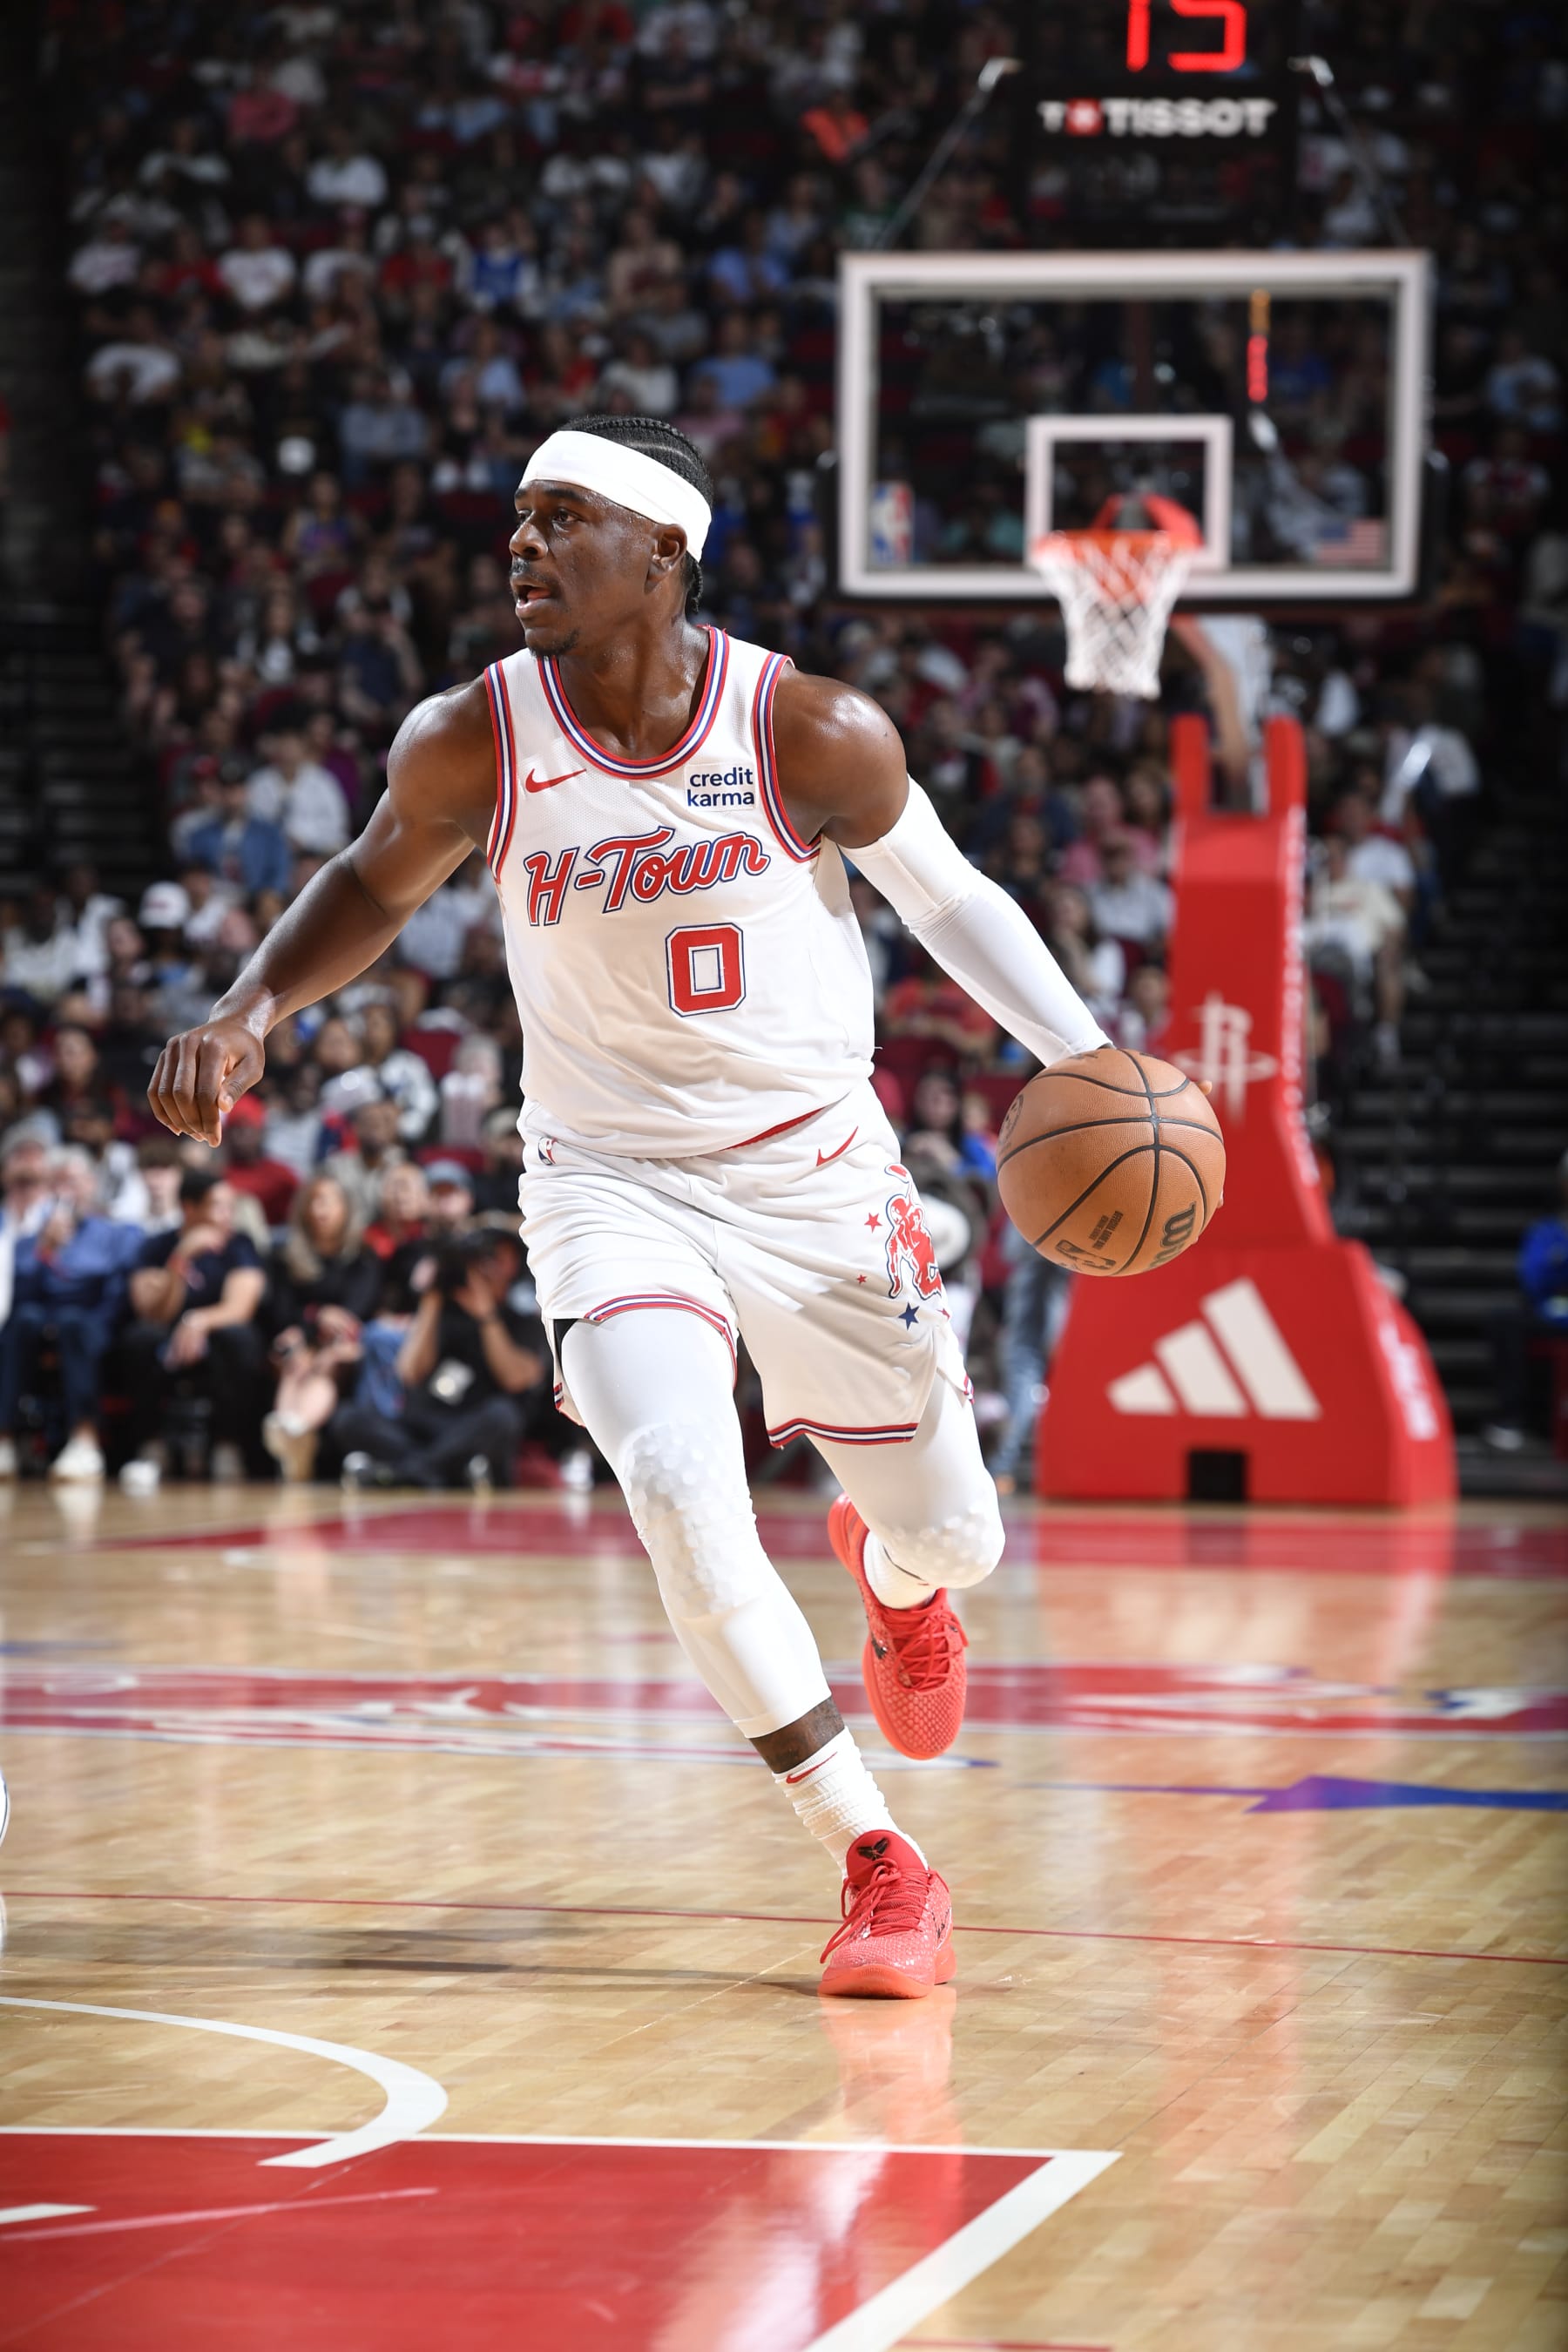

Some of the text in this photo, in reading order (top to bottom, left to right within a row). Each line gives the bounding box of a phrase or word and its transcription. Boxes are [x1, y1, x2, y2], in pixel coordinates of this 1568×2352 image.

[1101, 98, 1276, 137] TISSOT
[689, 767, 754, 787] credit
[686, 788, 755, 808] karma
[524, 827, 771, 927] H-Town
[666, 923, 747, 1017] 0
